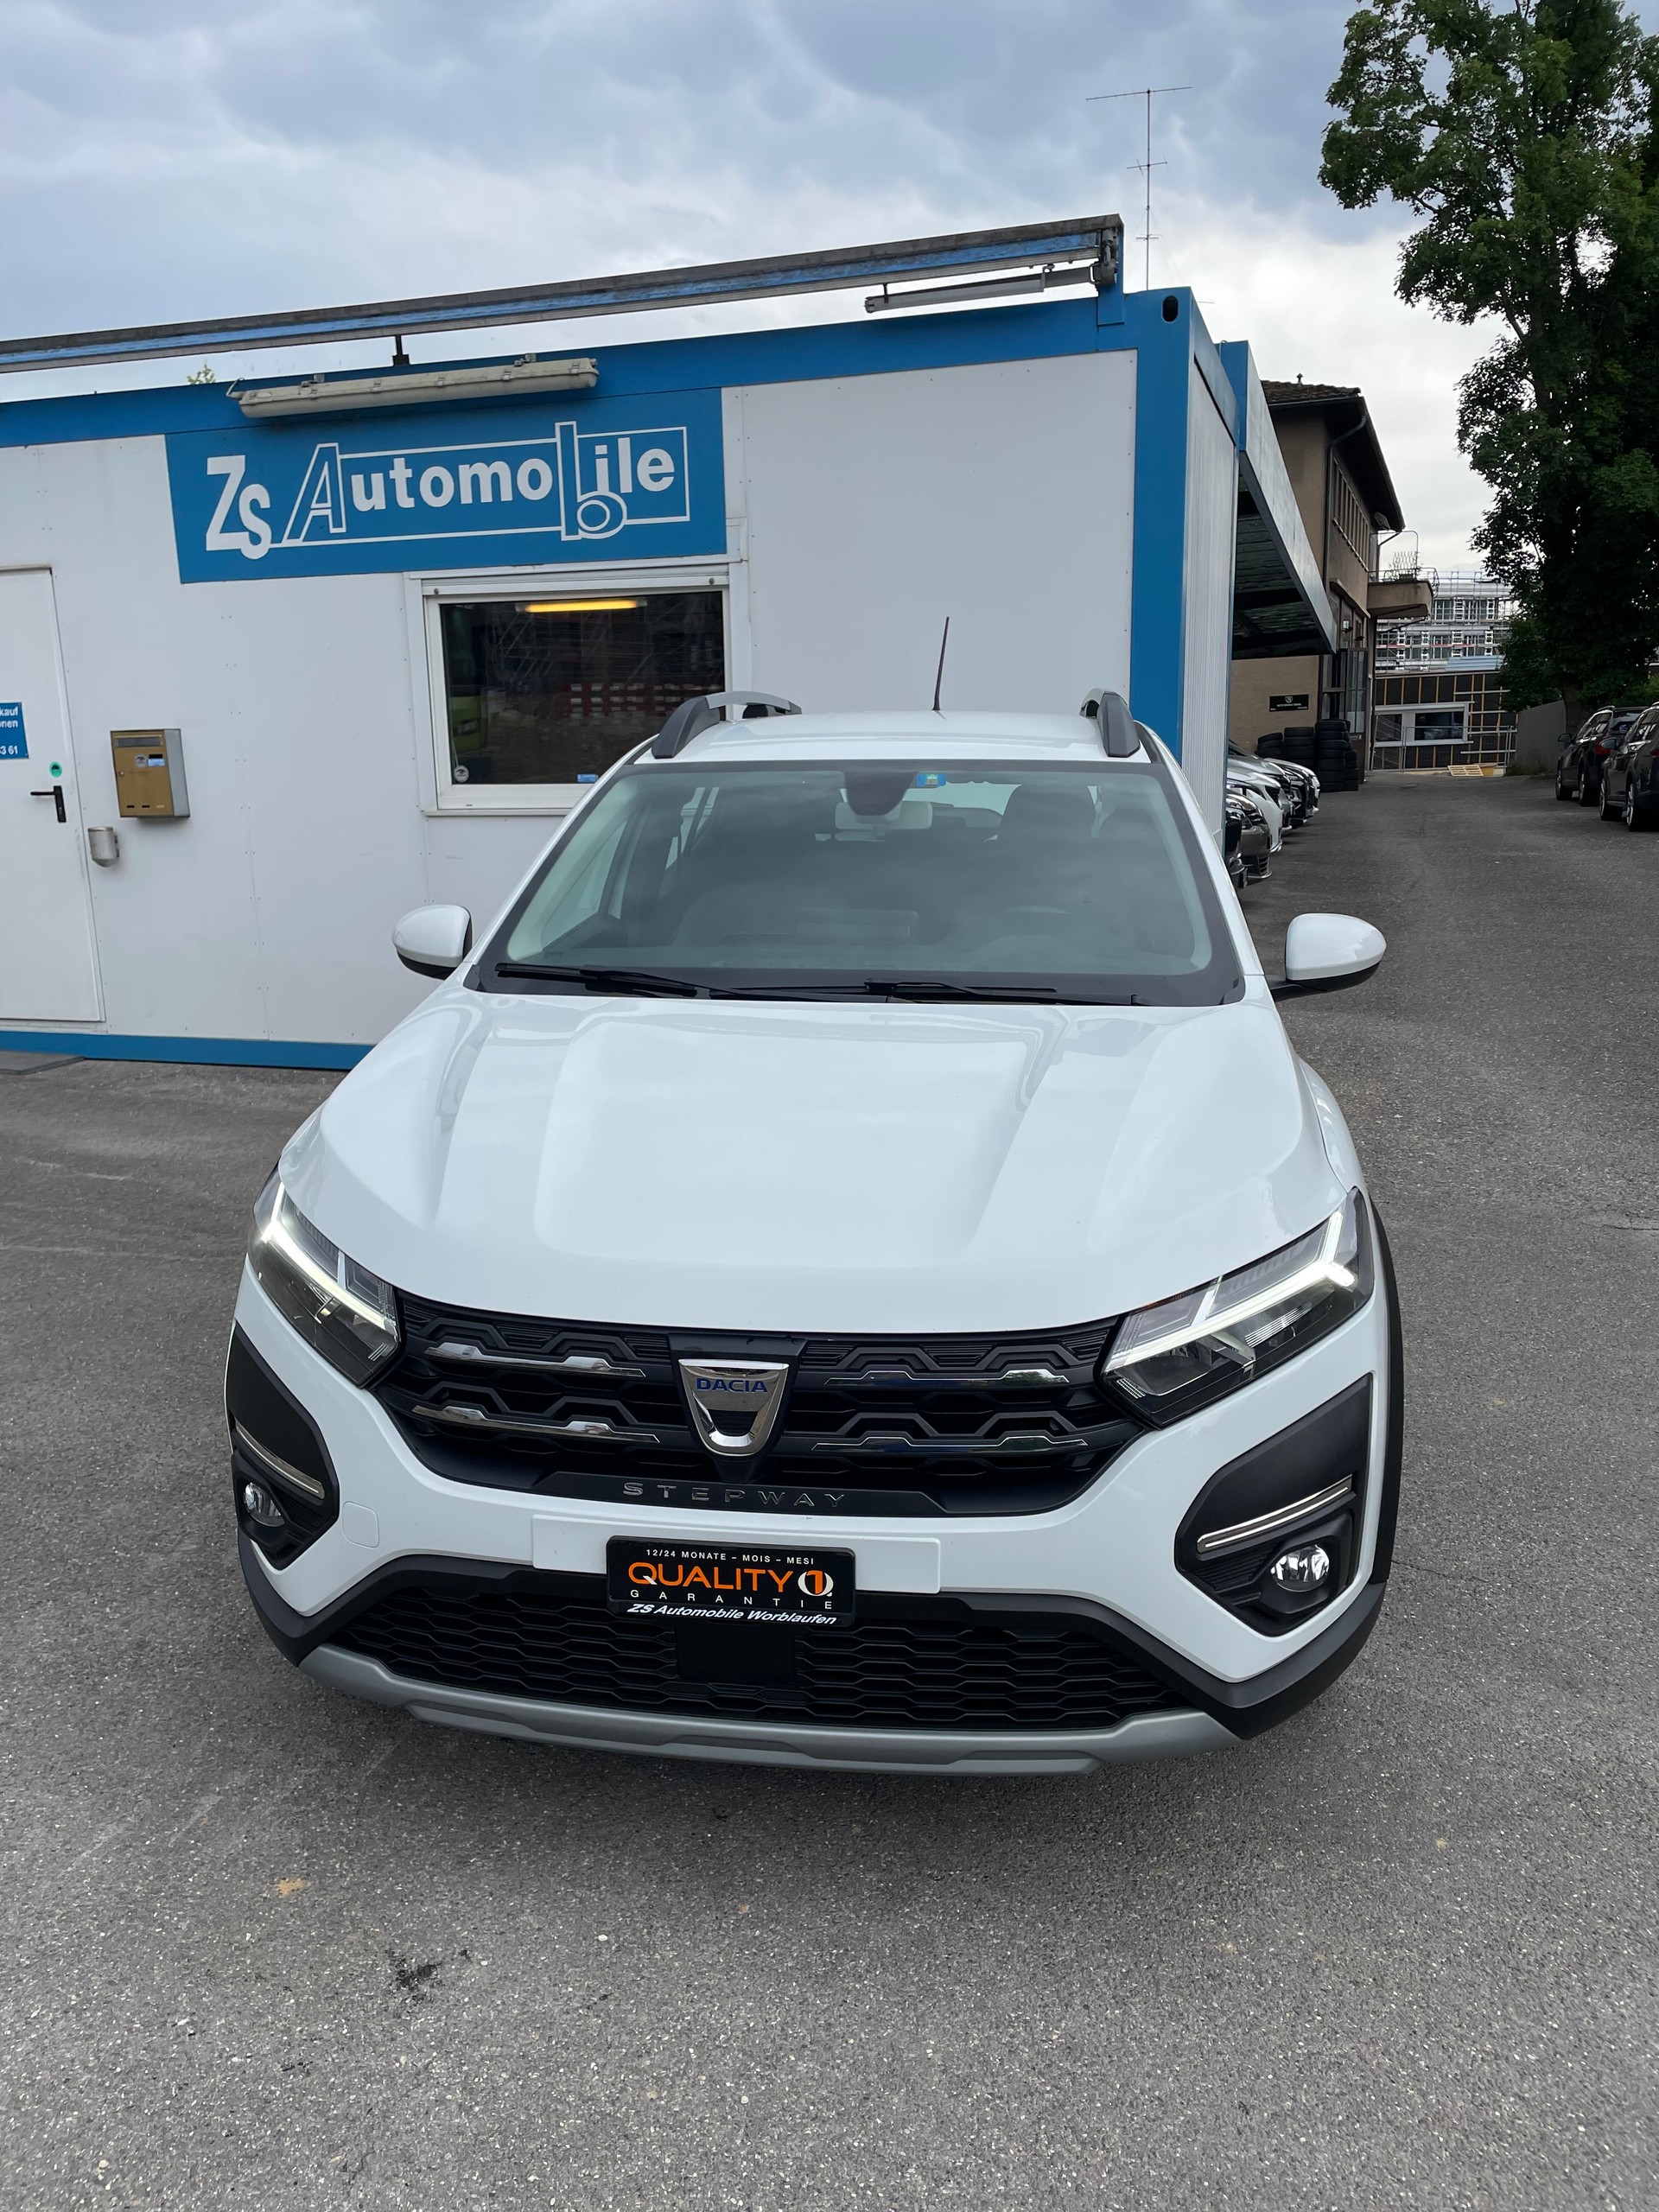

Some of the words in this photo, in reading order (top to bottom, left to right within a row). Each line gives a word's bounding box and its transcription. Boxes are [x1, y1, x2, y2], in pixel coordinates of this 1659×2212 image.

[279, 421, 676, 543] Automobile
[697, 1379, 768, 1393] DACIA
[622, 1482, 845, 1507] STEPWAY
[682, 1551, 727, 1560] MONATE
[742, 1554, 771, 1563] MOIS
[786, 1556, 814, 1565] MESI
[628, 1561, 793, 1592] QUALITY
[631, 1589, 833, 1610] GARANTIE
[626, 1604, 654, 1613] ZS
[654, 1605, 744, 1620] Automobile
[747, 1611, 837, 1624] Worblaufen
